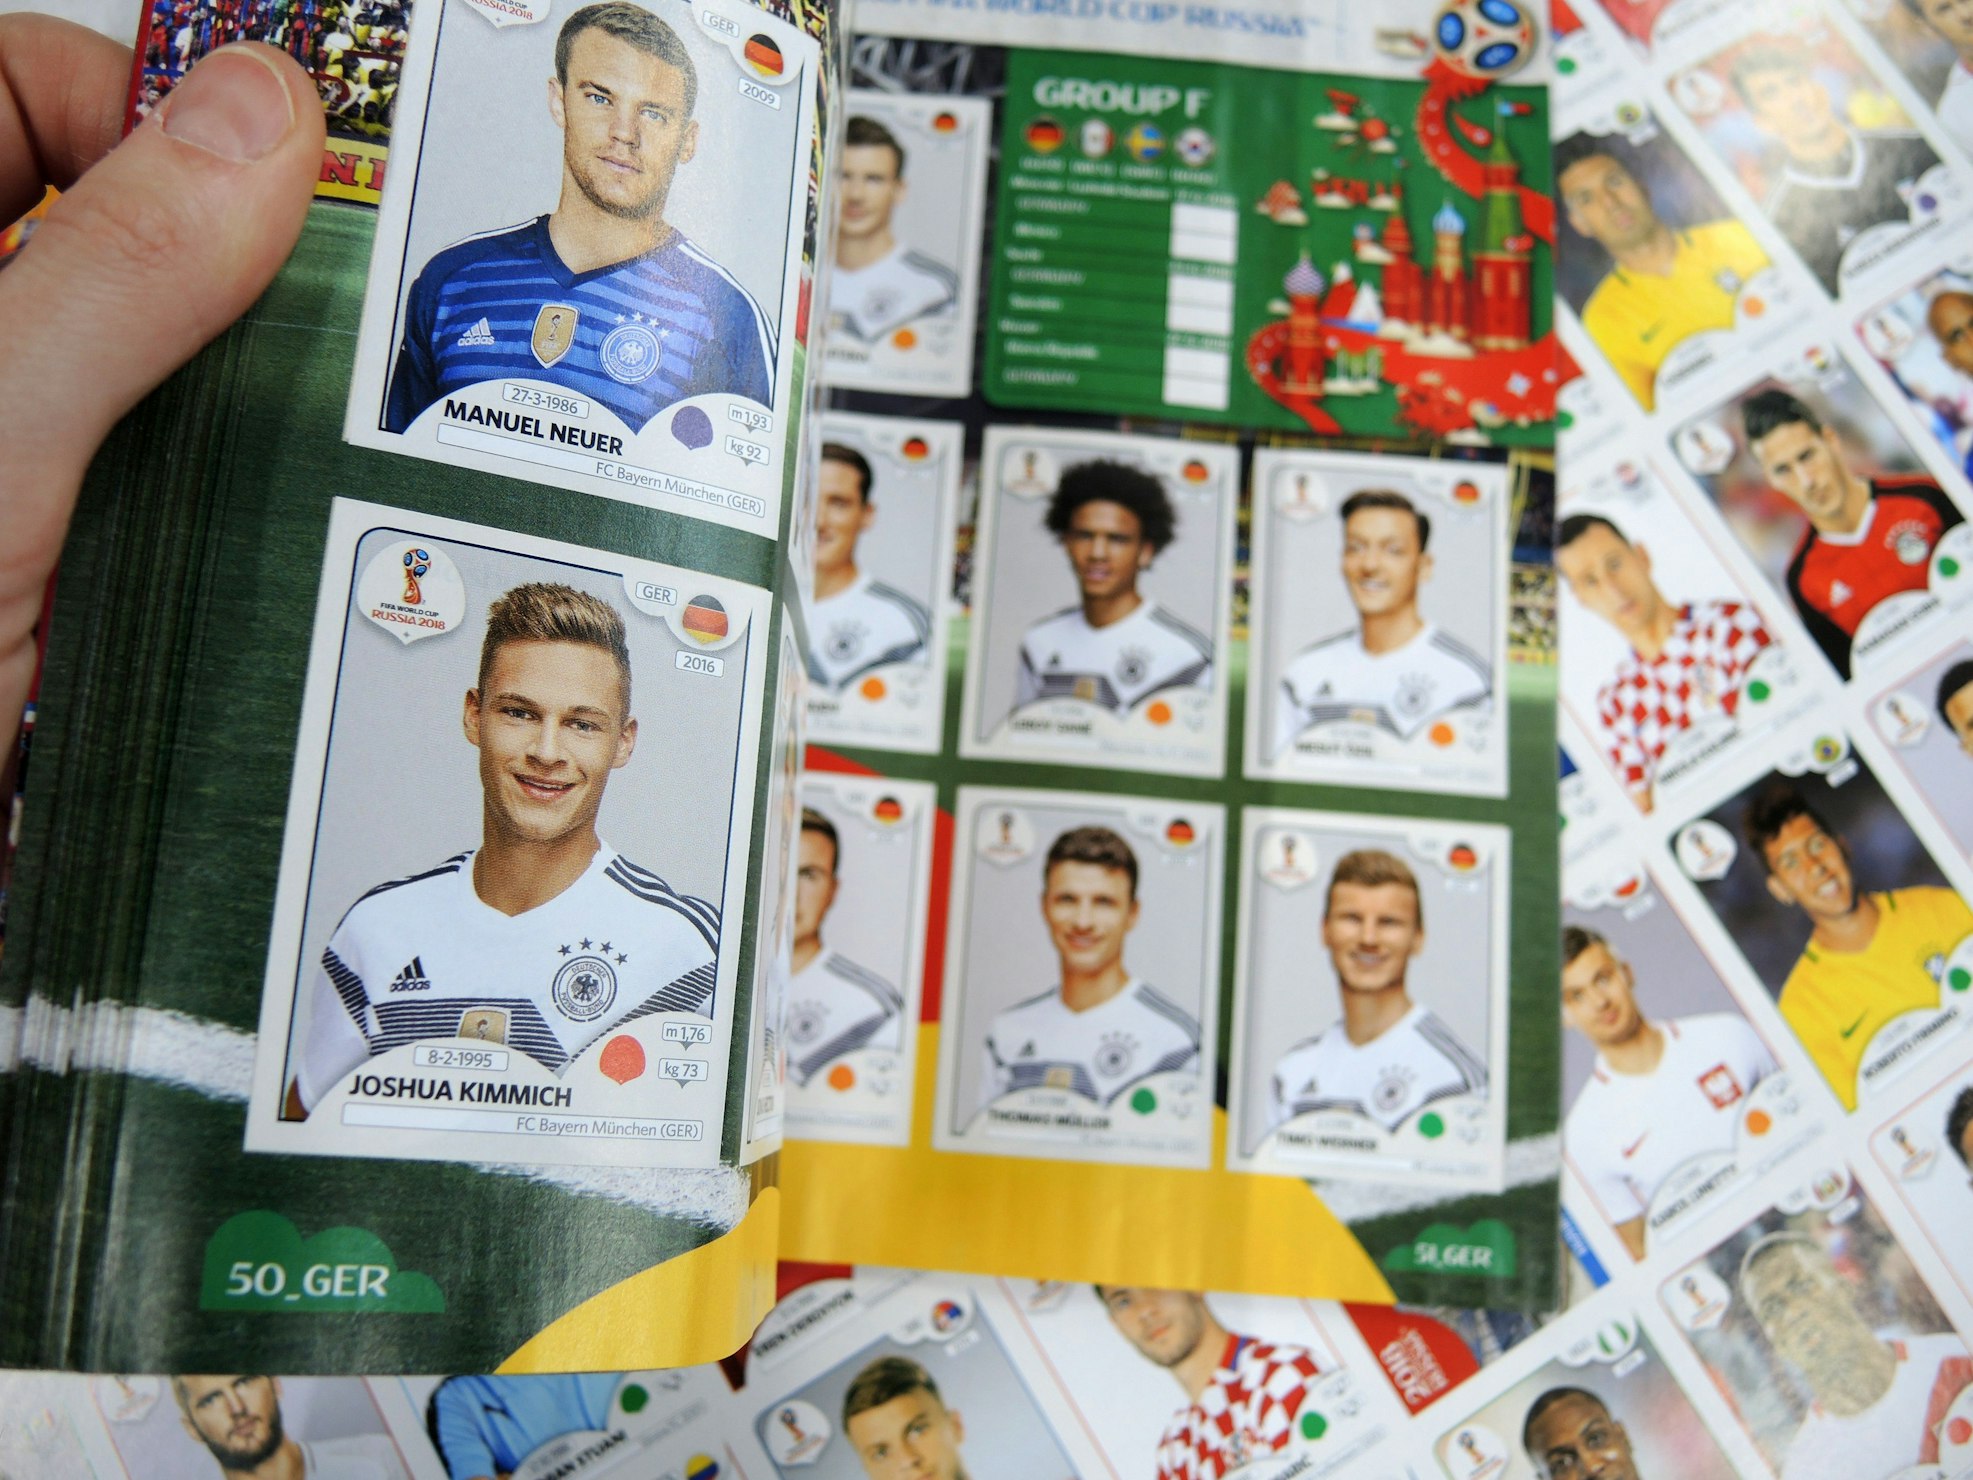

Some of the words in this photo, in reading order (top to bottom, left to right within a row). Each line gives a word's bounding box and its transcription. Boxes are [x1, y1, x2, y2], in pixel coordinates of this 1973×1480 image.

[509, 7, 533, 20] 2018
[709, 15, 735, 34] GER
[743, 83, 776, 105] 2009
[1032, 75, 1182, 116] GROUP
[1184, 86, 1211, 119] F
[457, 335, 495, 347] adidas
[511, 388, 578, 414] 27-3-1986
[444, 399, 544, 438] MANUEL
[550, 423, 623, 456] NEUER
[731, 409, 743, 420] m
[745, 411, 768, 429] 1,93
[730, 439, 744, 456] kg
[746, 446, 761, 460] 92
[596, 462, 614, 476] FC
[617, 467, 662, 490] Bayern
[664, 478, 724, 503] München
[726, 495, 762, 515] (GER)
[643, 585, 671, 602] GER
[380, 602, 396, 611] FIFA
[397, 605, 423, 615] WORLD
[372, 609, 416, 625] RUSSIA
[416, 618, 446, 630] 2018
[683, 655, 716, 673] 2016
[390, 978, 431, 993] adidas
[666, 1027, 678, 1037] m
[681, 1026, 706, 1042] 1,76
[428, 1049, 493, 1068] 8-2-1995
[664, 1062, 679, 1077] kg
[682, 1063, 699, 1077] 73
[349, 1074, 453, 1101] JOSHUA
[459, 1081, 572, 1107] KIMMICH
[517, 1117, 536, 1131] FC
[539, 1118, 588, 1137] Bayern
[591, 1120, 657, 1137] München
[660, 1122, 699, 1139] (GER)
[225, 1260, 390, 1302] 50_GER
